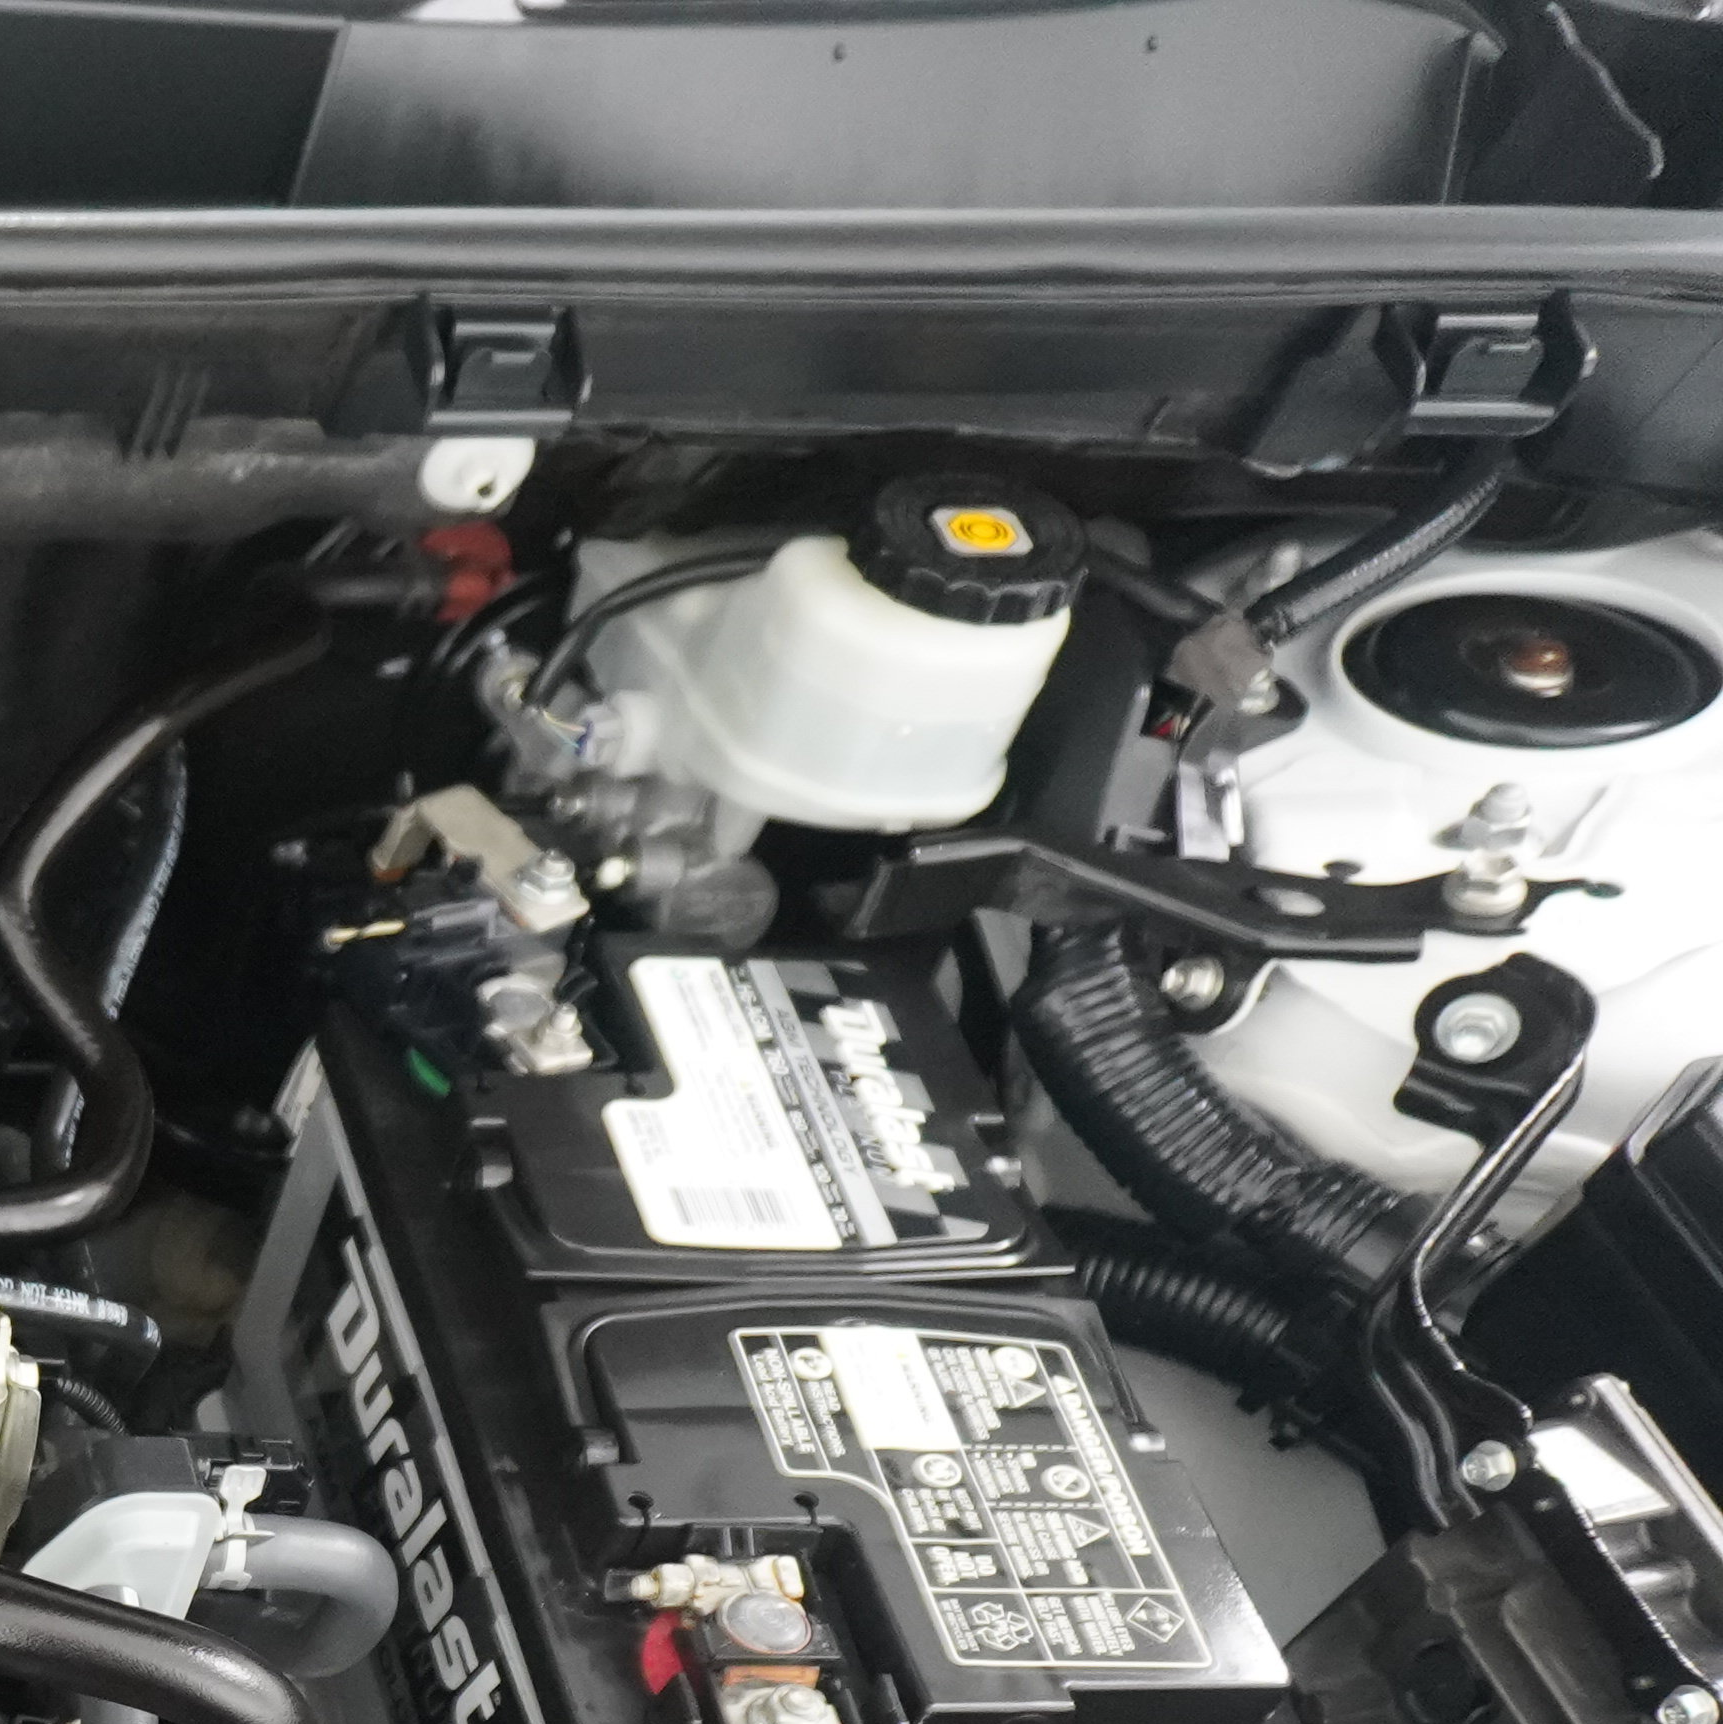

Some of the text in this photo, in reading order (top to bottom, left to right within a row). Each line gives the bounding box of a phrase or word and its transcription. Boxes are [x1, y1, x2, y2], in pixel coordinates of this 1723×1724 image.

[773, 1008, 860, 1176] AGM TECHNOLOGY
[823, 999, 958, 1192] Duralast
[829, 1070, 897, 1181] PLNUM
[751, 1354, 795, 1446] Lead Acid Battery
[764, 1349, 816, 1453] NON-SPILLABLE
[807, 1381, 846, 1457] INSTRUCTIONS
[819, 1380, 842, 1411] READ
[1056, 1392, 1153, 1555] DANGER/POISON
[949, 1552, 980, 1579] NOT
[972, 1555, 999, 1576] DO
[1029, 1596, 1053, 1619] HELP
